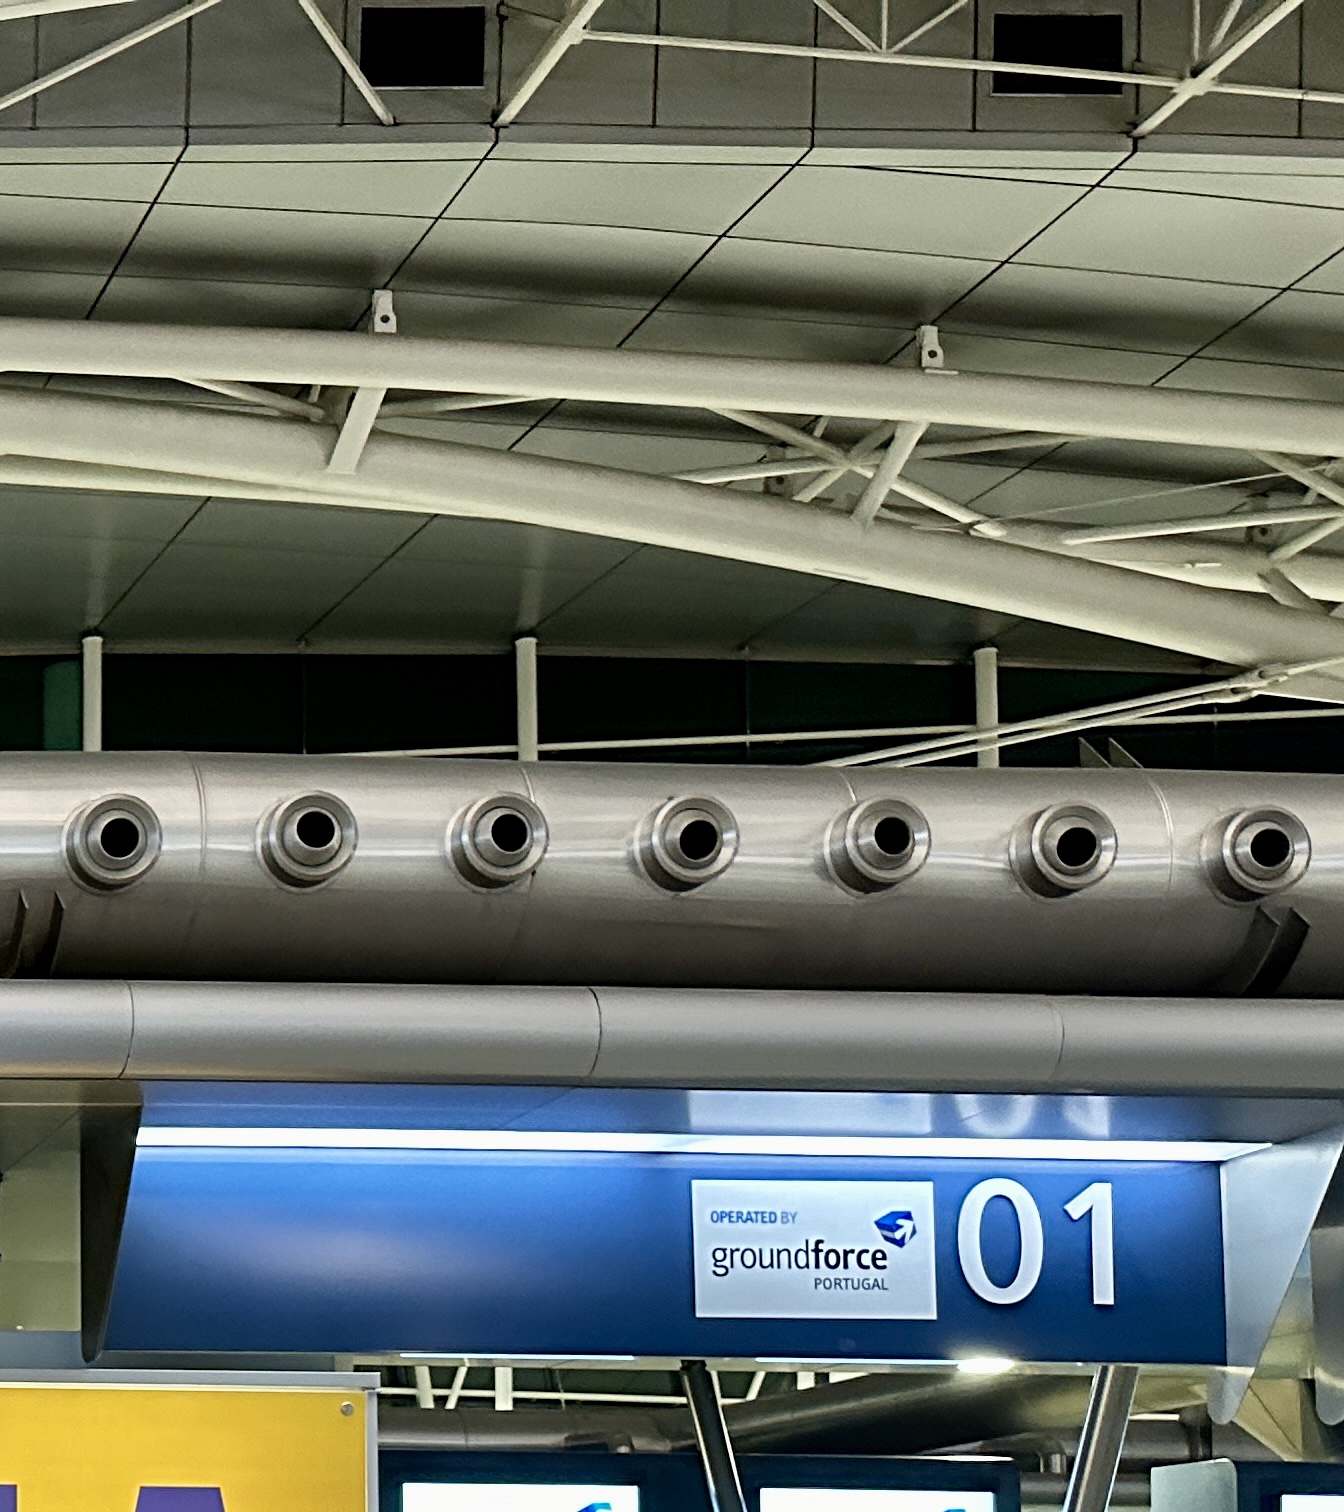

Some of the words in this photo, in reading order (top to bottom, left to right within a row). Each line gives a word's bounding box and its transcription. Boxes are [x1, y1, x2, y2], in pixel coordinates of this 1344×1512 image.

[710, 1210, 778, 1224] OPERATED
[780, 1211, 798, 1224] BY
[957, 1177, 1115, 1306] 01
[711, 1239, 888, 1277] groundforce
[814, 1277, 889, 1291] PORTUGAL
